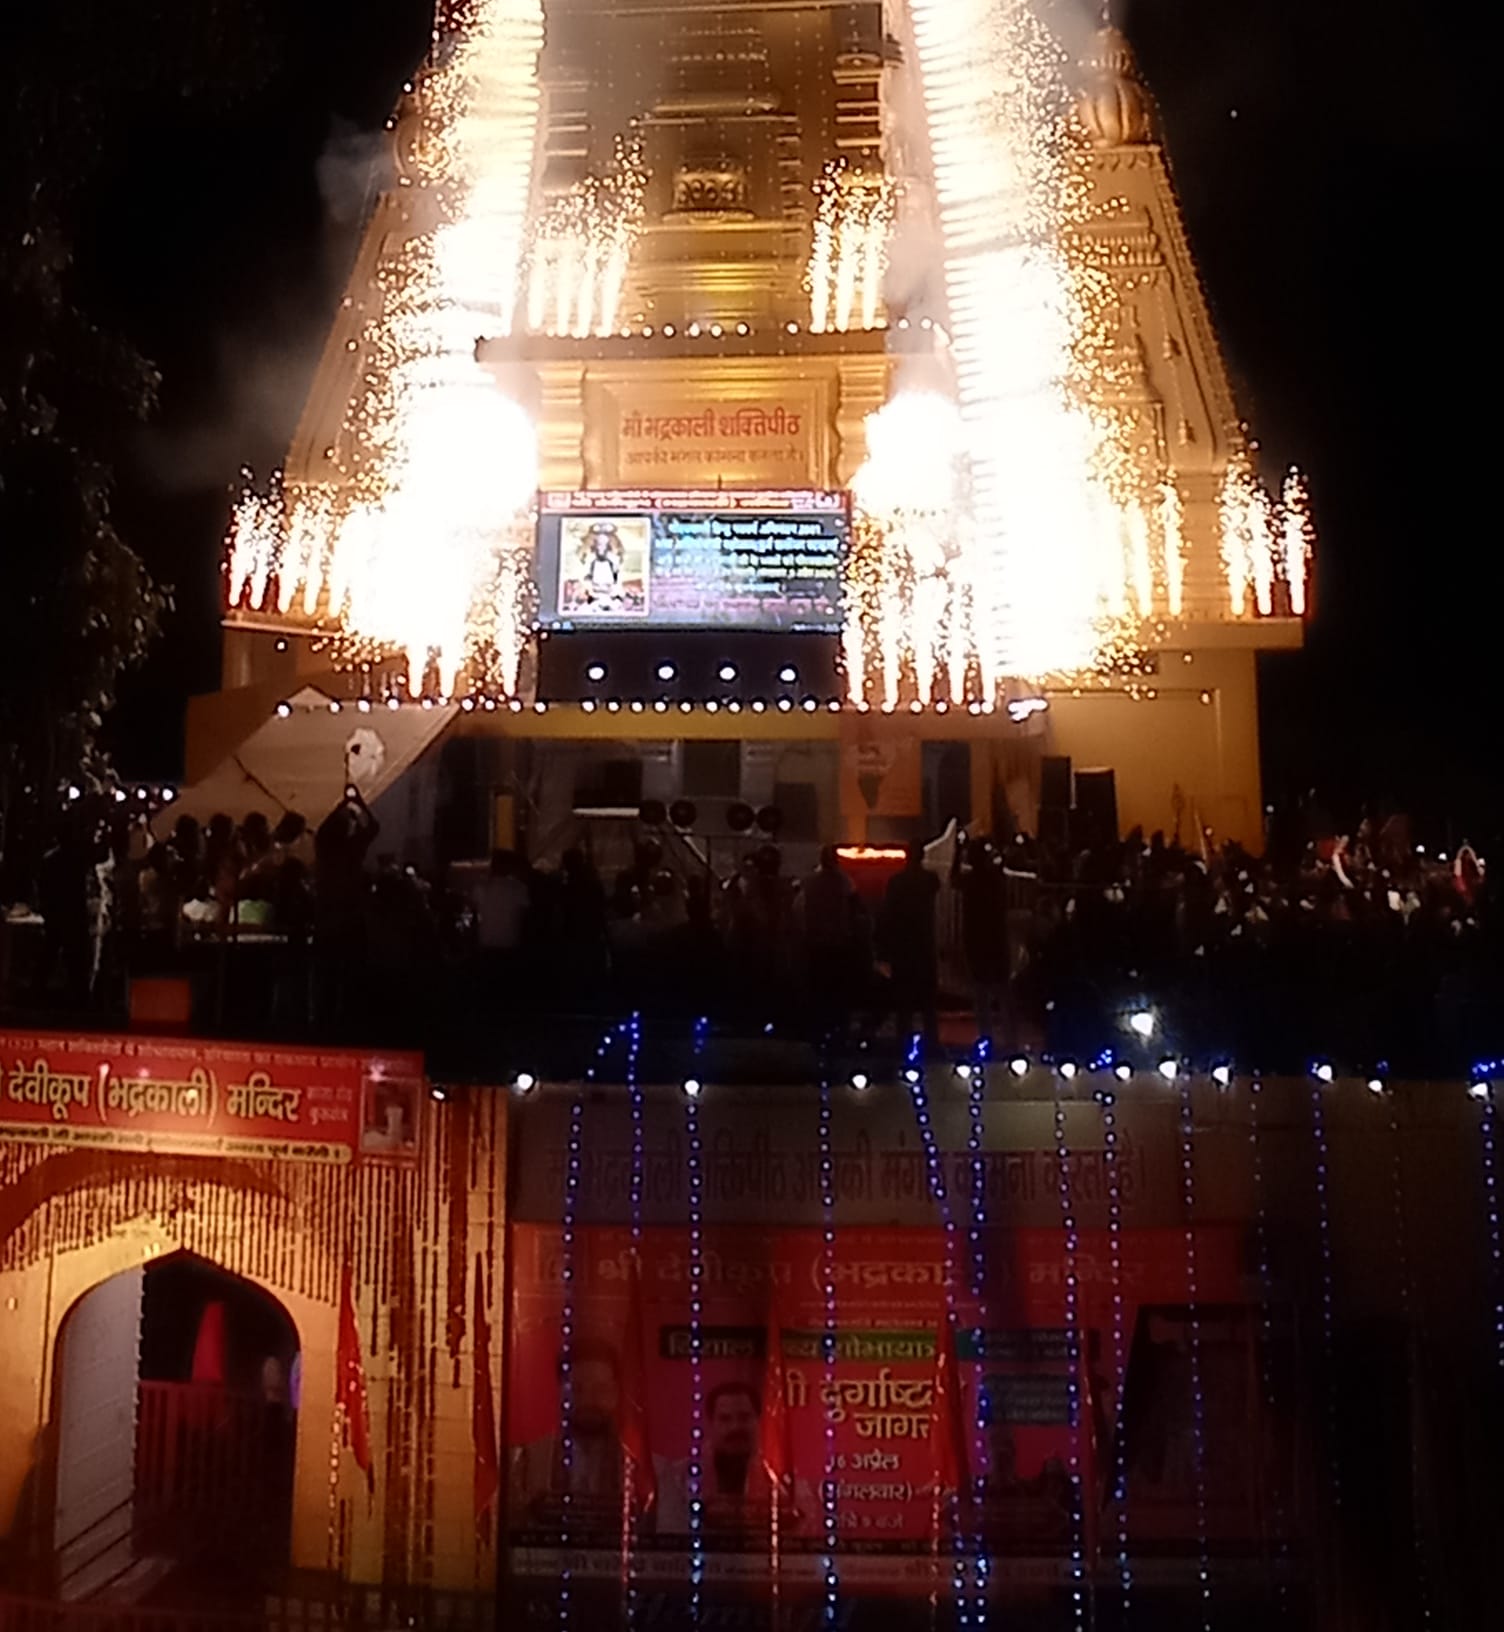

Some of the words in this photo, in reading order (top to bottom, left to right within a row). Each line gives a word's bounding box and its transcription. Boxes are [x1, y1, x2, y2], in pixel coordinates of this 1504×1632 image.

[644, 408, 715, 441] भद्रकाली
[718, 405, 801, 438] शक्तिपीठ
[8, 1058, 91, 1119] देवीकूप
[98, 1063, 217, 1128] (भद्रकाली)
[226, 1072, 302, 1122] मन्दिर
[789, 1128, 873, 1202] आकी
[879, 1130, 949, 1202] मंग
[853, 1412, 931, 1440] जागर
